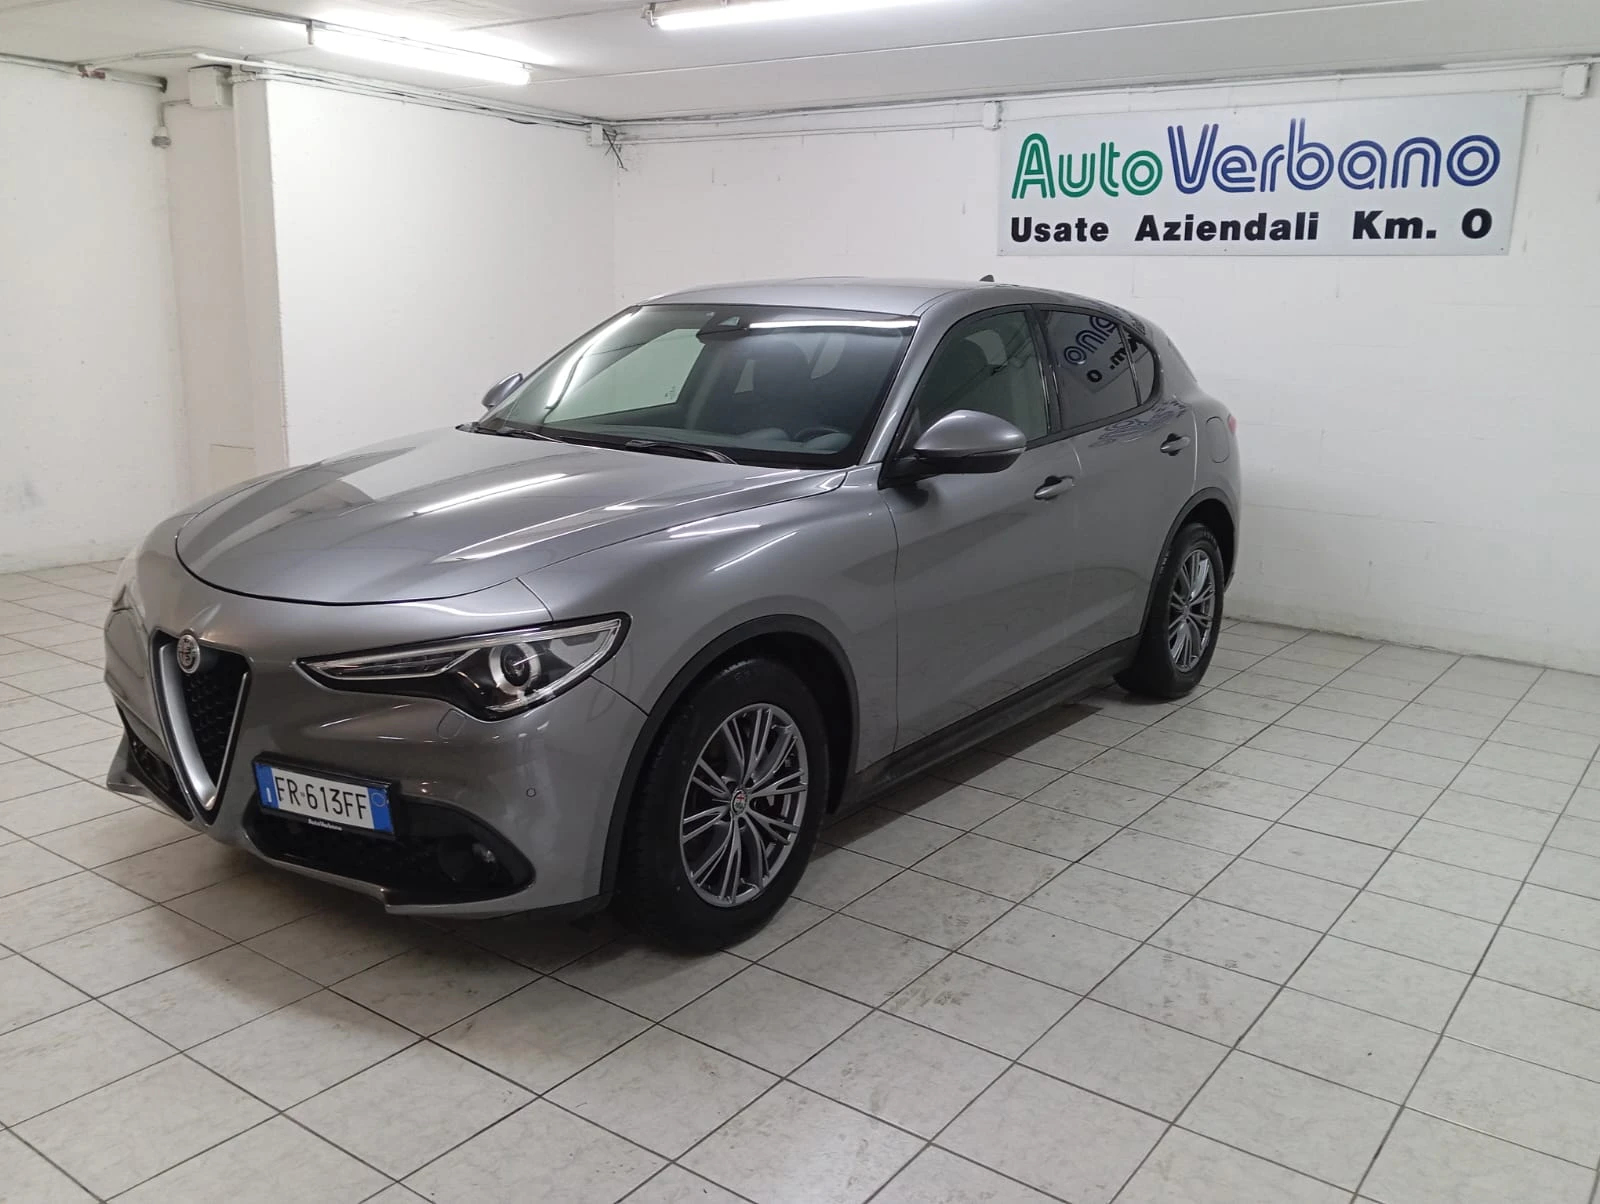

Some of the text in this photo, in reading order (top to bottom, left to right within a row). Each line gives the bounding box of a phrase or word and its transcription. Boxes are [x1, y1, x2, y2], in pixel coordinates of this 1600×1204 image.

[1010, 216, 1109, 242] Usate
[1135, 210, 1319, 241] Aziendali
[1351, 208, 1437, 240] Km.
